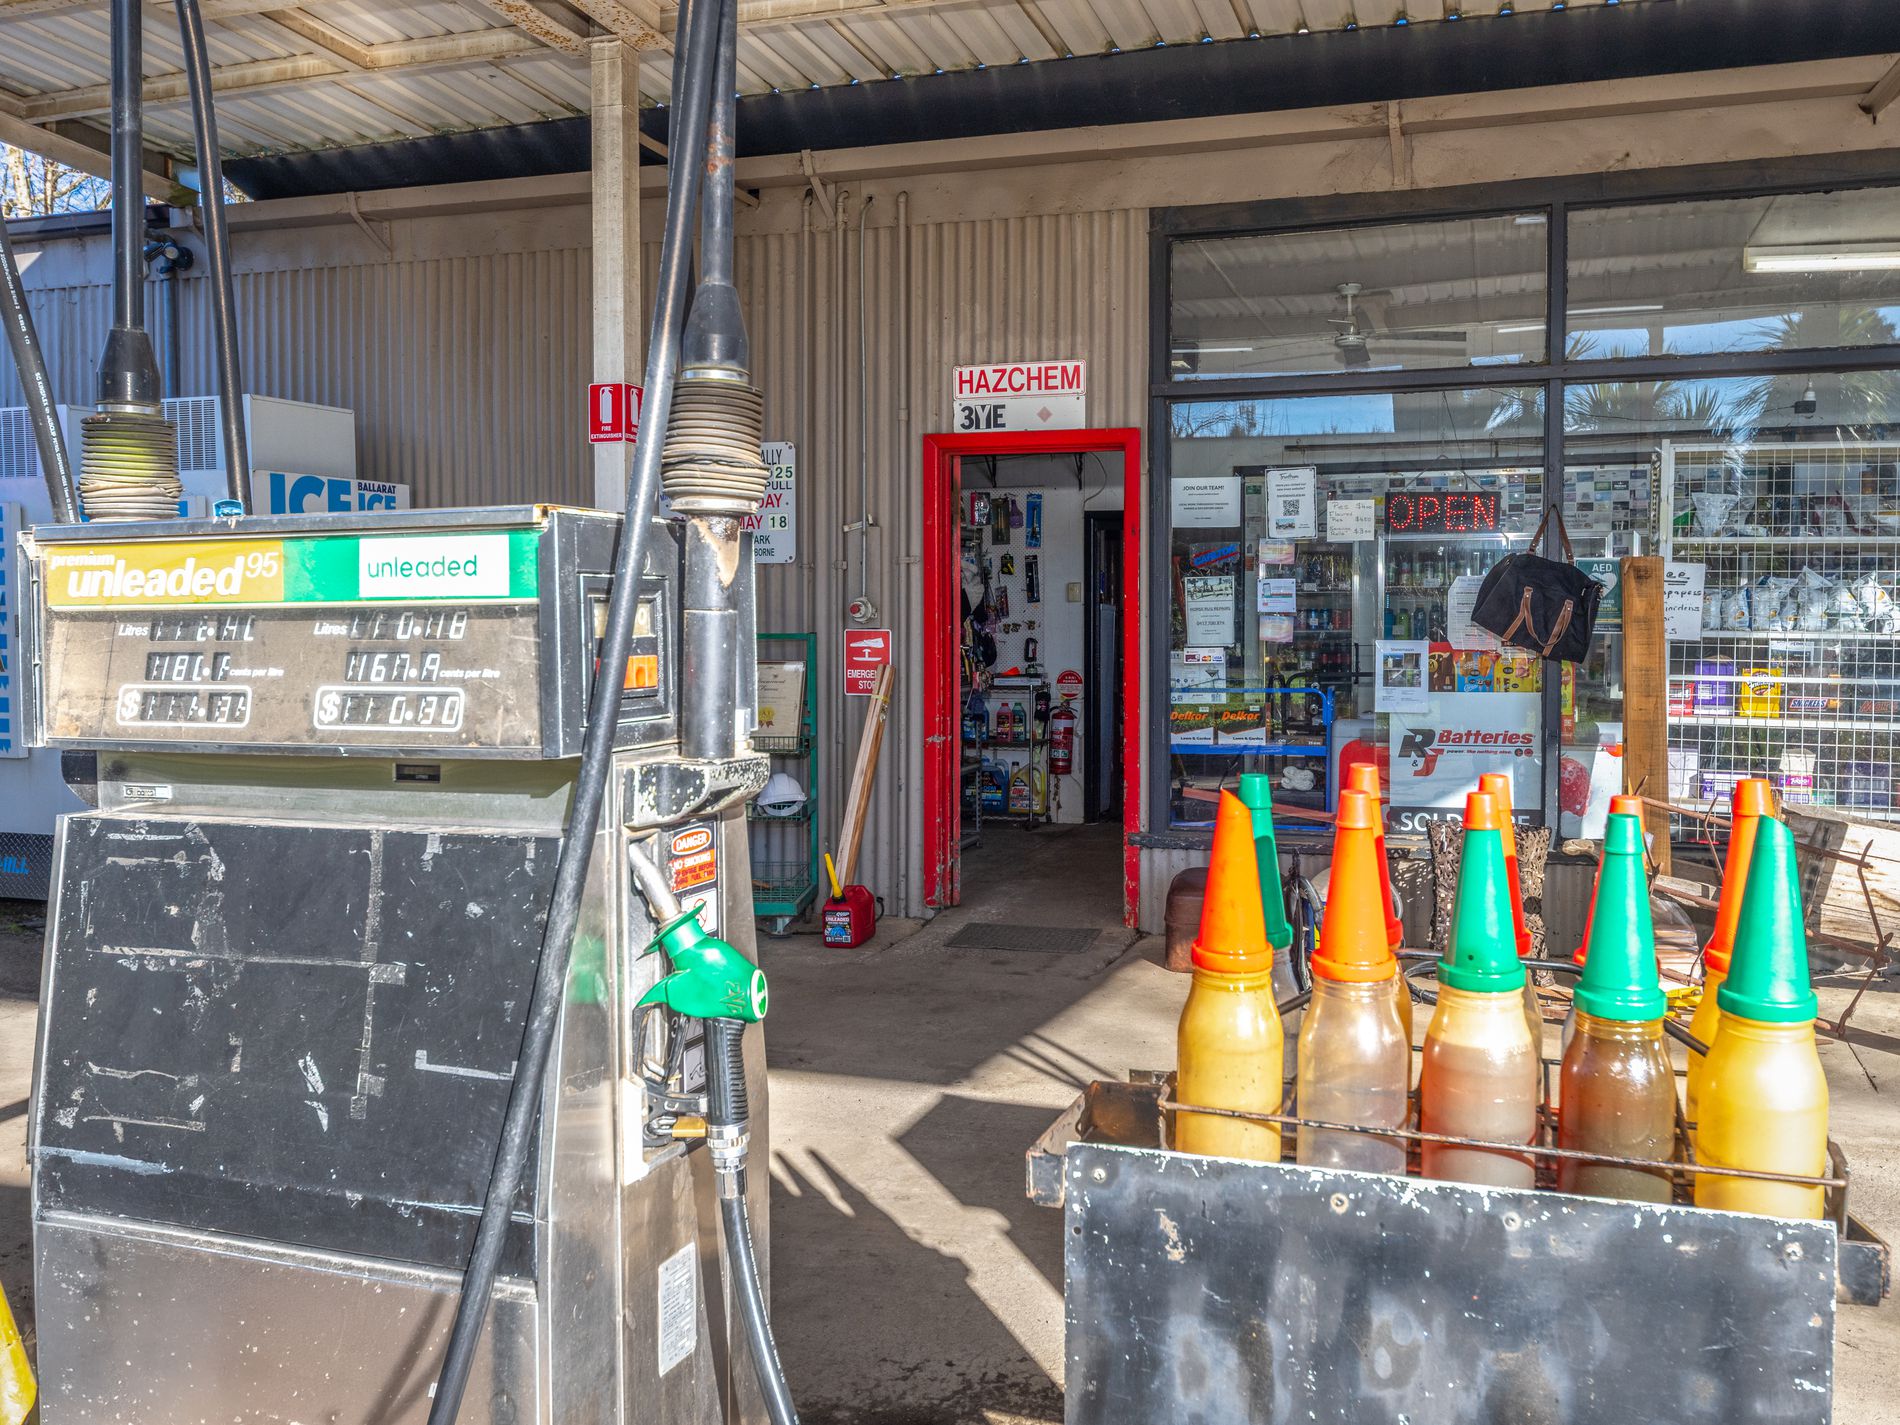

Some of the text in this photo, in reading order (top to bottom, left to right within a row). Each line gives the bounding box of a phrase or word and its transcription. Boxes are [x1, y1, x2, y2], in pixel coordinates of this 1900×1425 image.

[959, 365, 1081, 394] HAZCHEM
[960, 404, 1006, 430] 3YE
[775, 466, 793, 478] 25
[270, 473, 352, 514] ICE
[358, 482, 396, 494] BALLARAT
[358, 493, 396, 511] ICE
[1390, 495, 1494, 529] OPEN
[770, 516, 787, 528] 18
[51, 551, 115, 569] premium
[366, 554, 478, 578] unleaded
[67, 552, 279, 598] unleaded 95
[1592, 564, 1612, 572] AED
[118, 624, 148, 636] Litres
[313, 622, 348, 636] Litres
[230, 667, 284, 678] cents per litre
[440, 668, 500, 679] cents per litre
[848, 670, 876, 678] EMERGE
[1791, 698, 1827, 708] SNICKERS
[1398, 728, 1436, 758] R
[1438, 730, 1534, 744] Batteries
[676, 832, 707, 851] DANGER
[684, 851, 711, 868] SMOKING
